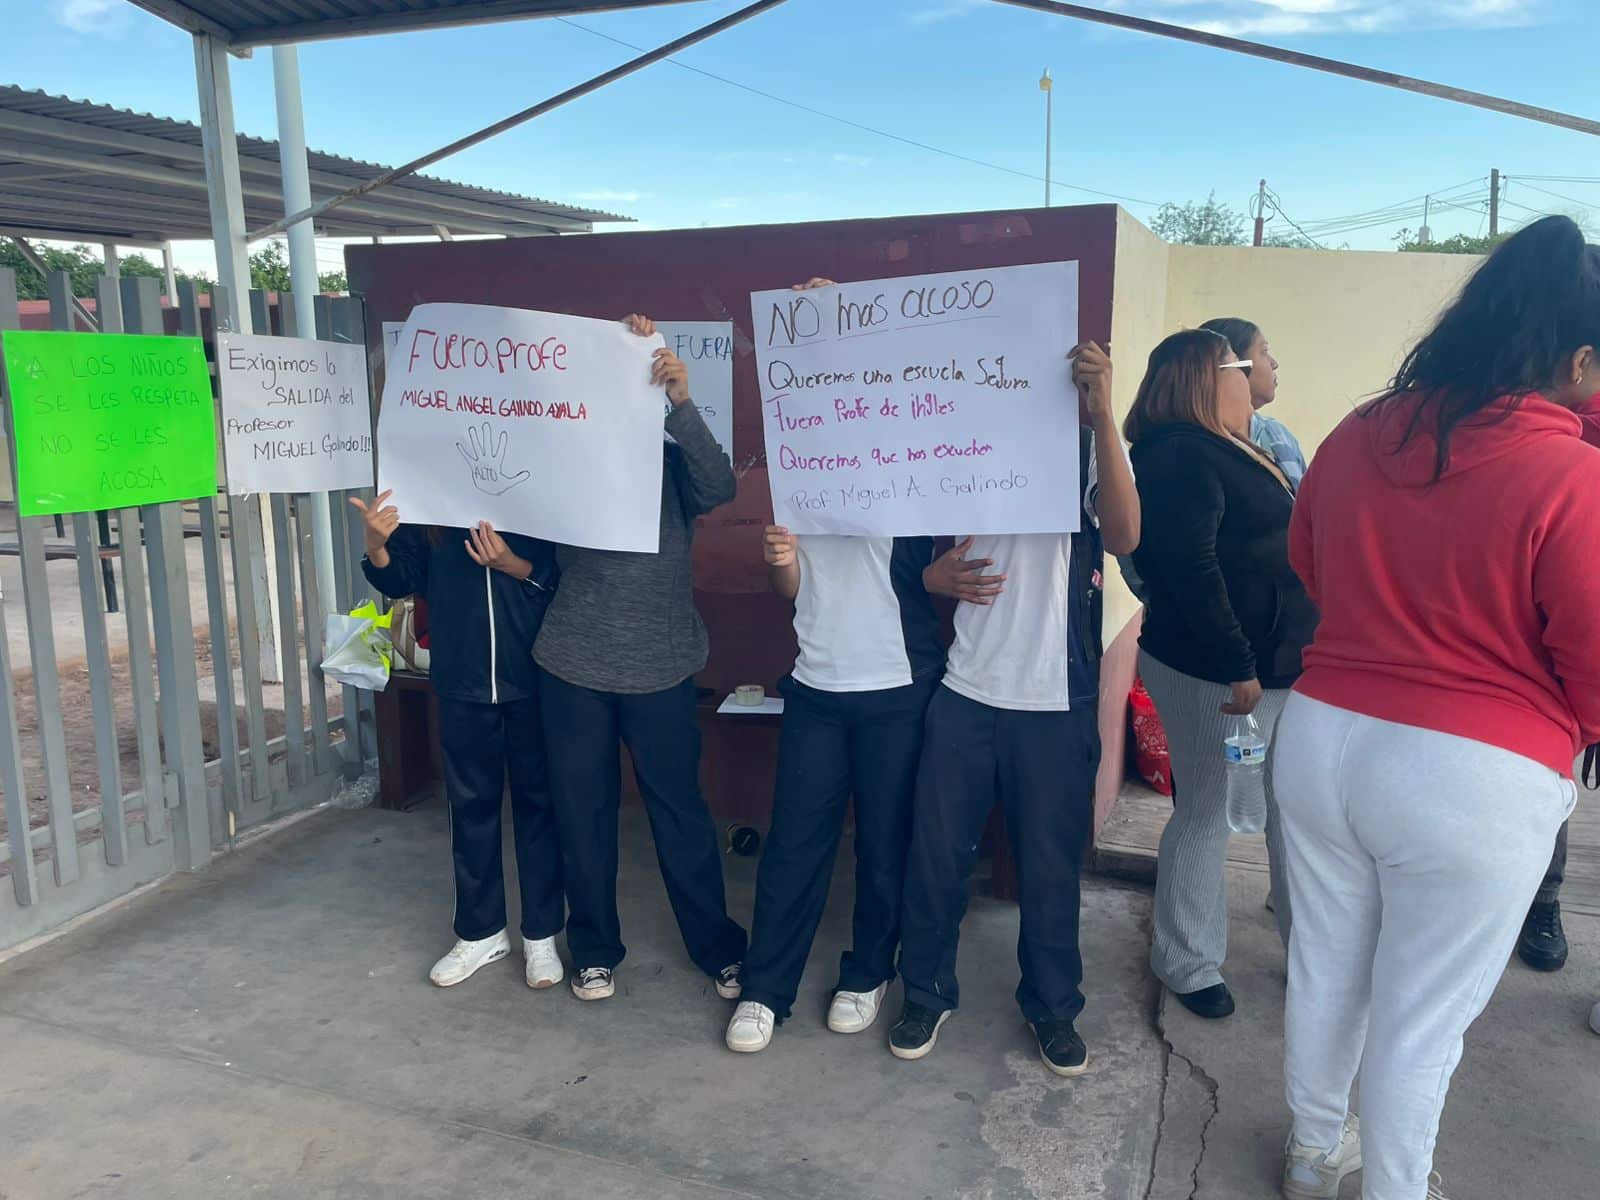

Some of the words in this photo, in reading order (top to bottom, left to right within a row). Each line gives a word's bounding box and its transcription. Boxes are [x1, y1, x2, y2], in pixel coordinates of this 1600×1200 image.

[769, 296, 820, 346] NO
[901, 279, 994, 319] acoso
[408, 328, 495, 373] Fuera
[674, 333, 733, 361] FUERA
[29, 354, 48, 379] A
[70, 354, 116, 378] LOS
[130, 351, 189, 377] NIÑOS
[228, 348, 318, 391] Exigimos
[326, 352, 337, 376] la
[767, 360, 855, 391] Queremos
[863, 369, 894, 386] una
[902, 359, 967, 383] escuela
[33, 394, 71, 415] SE
[88, 392, 121, 411] LES
[130, 384, 201, 408] RESPETA
[267, 386, 333, 406] SALIDA
[338, 388, 354, 406] del
[400, 389, 455, 412] MIGUEL
[456, 395, 496, 415] ANGEL
[544, 400, 587, 420] AYALA
[834, 396, 870, 423] Profe
[879, 397, 900, 418] de
[41, 432, 72, 455] NO
[96, 431, 121, 453] SE
[134, 426, 169, 446] LES
[226, 417, 295, 436] Profesor
[253, 440, 318, 461] MIGUEL
[779, 443, 862, 471] Queremos
[871, 447, 900, 466] que
[99, 464, 167, 492] ACOSA
[840, 478, 897, 511] Miguel
[939, 469, 1030, 497] Galindo
